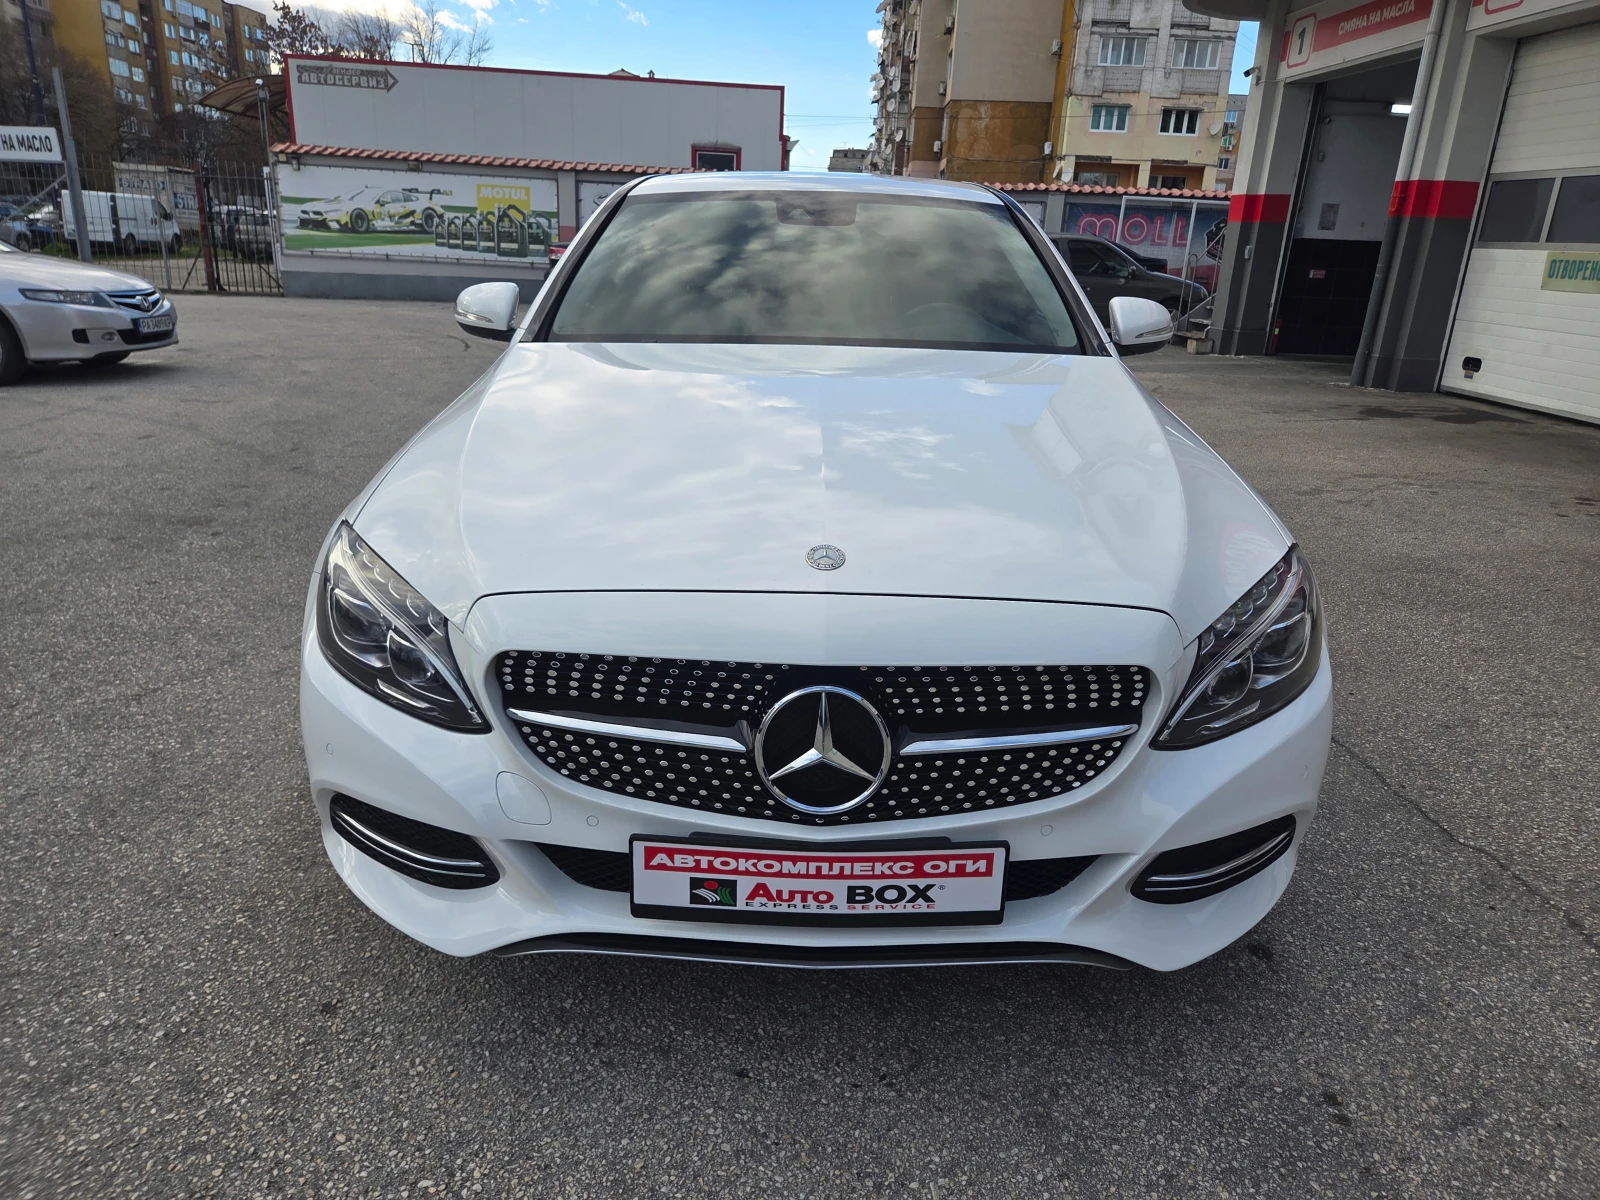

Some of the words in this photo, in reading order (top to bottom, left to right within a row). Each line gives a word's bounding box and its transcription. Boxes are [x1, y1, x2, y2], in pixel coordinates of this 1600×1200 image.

[1338, 17, 1367, 35] СМЯНА
[1368, 10, 1381, 25] НА
[1381, 0, 1415, 19] МАСЛА
[1297, 27, 1307, 55] 1
[301, 72, 386, 88] АВТОСЕРВИЗ
[0, 134, 16, 151] НА
[16, 134, 53, 152] МАСЛО
[480, 186, 528, 200] MOTUL
[650, 853, 915, 876] АВТОКОМПЛЕКС
[923, 859, 987, 874] ОГИ
[745, 901, 839, 911] EXPRESS
[846, 903, 936, 911] SERVICE
